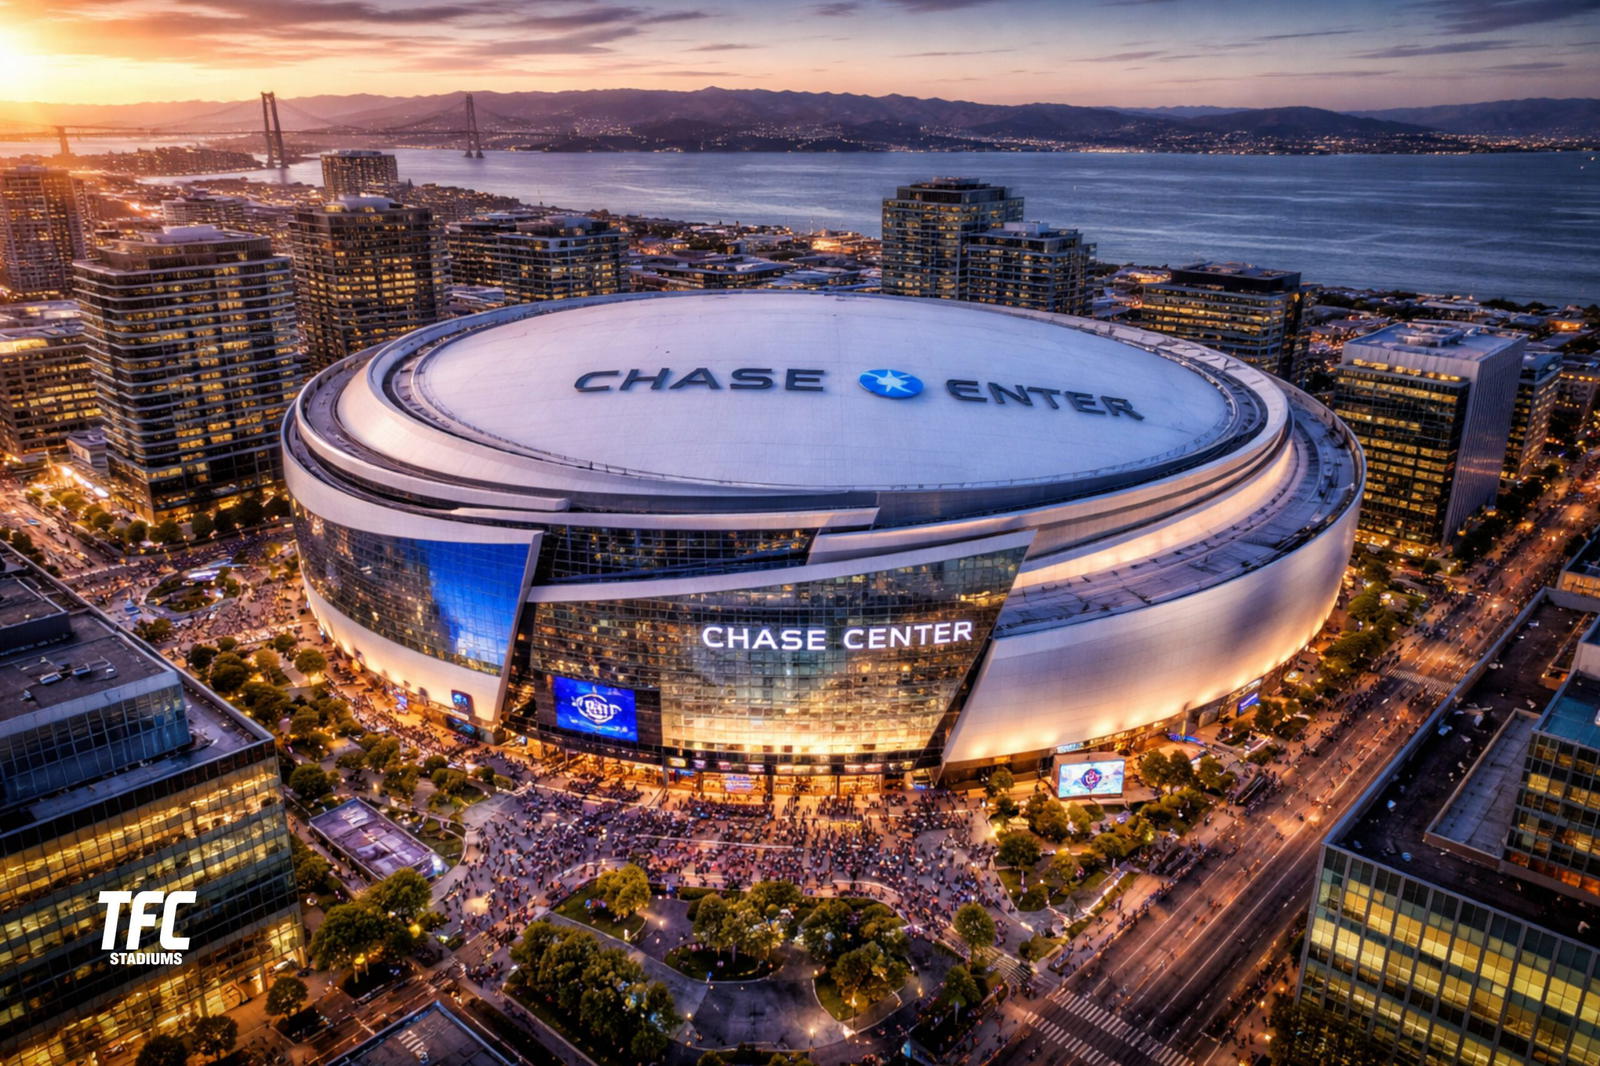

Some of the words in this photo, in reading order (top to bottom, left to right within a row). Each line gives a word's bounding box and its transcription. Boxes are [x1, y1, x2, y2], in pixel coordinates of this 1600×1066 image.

[574, 367, 825, 393] CHASE
[946, 378, 1145, 421] ENTER
[702, 627, 827, 651] CHASE
[843, 621, 973, 650] CENTER
